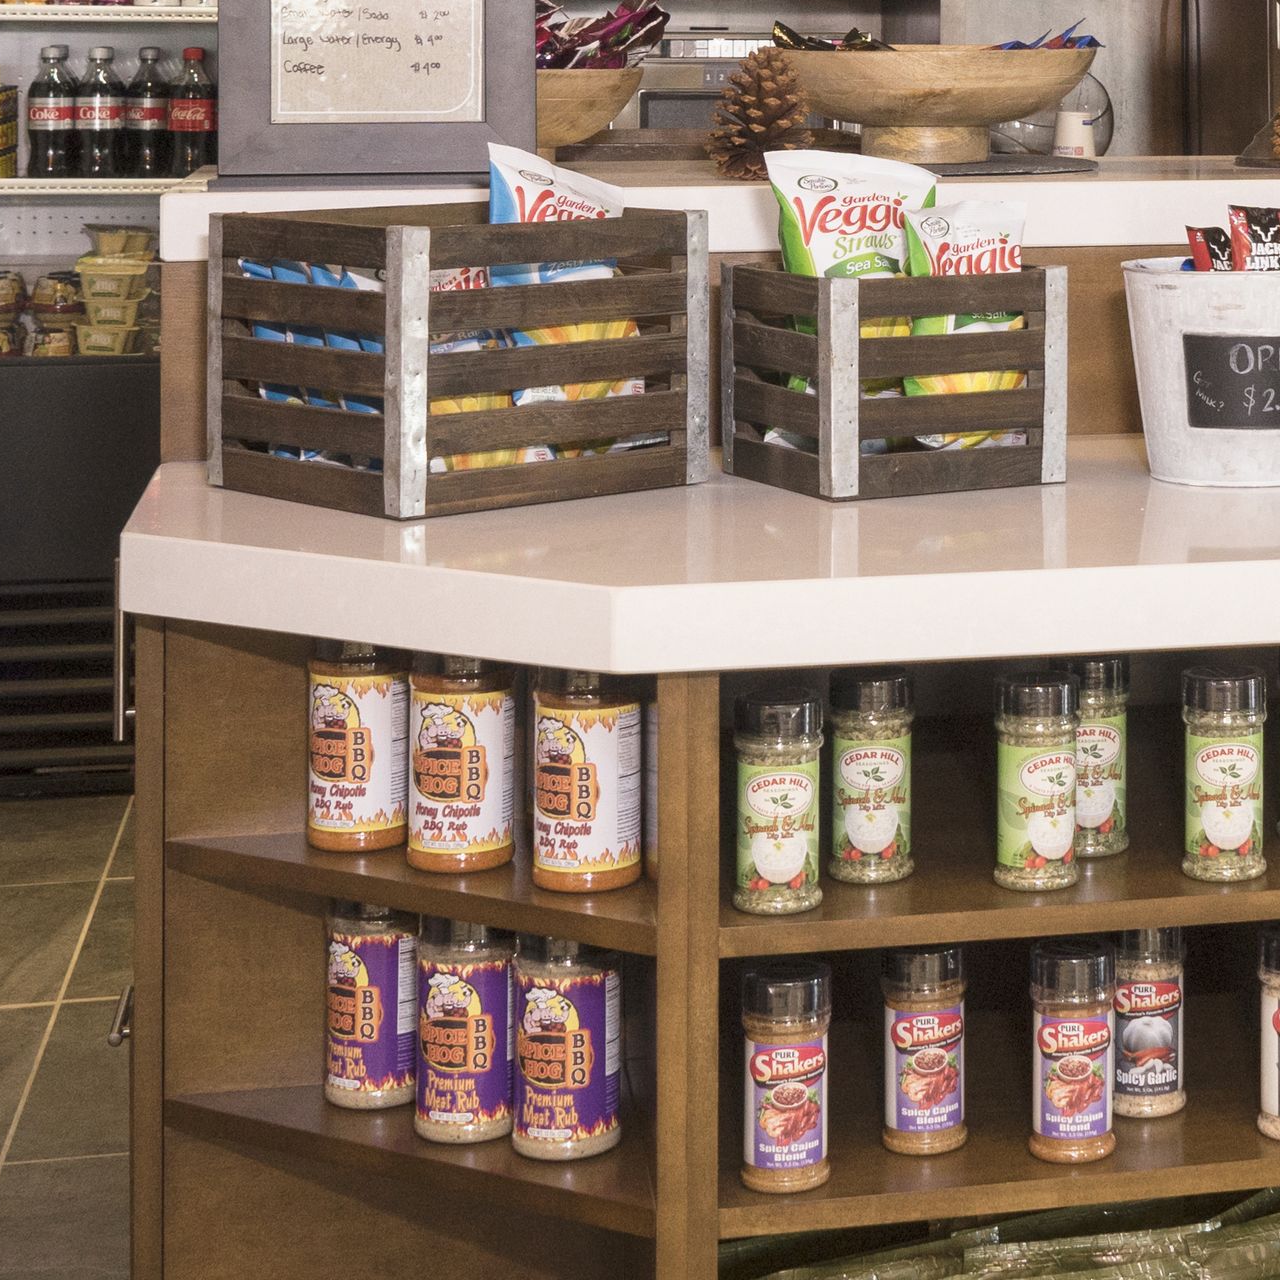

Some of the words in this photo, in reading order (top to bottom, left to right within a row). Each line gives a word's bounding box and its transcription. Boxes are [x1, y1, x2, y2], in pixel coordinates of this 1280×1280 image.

[282, 30, 315, 52] Large
[283, 59, 326, 76] Coffee
[30, 107, 60, 120] Coke
[79, 107, 110, 120] Coke
[556, 195, 596, 214] garden
[841, 192, 891, 207] garden
[832, 233, 897, 260] Straws
[951, 238, 996, 256] garden
[847, 261, 871, 274] Sea
[329, 782, 367, 800] Chipotle
[422, 775, 458, 794] HOG
[315, 798, 331, 811] BBQ
[335, 799, 354, 810] Rub
[441, 801, 481, 820] Chipotle
[422, 819, 444, 832] BBQ
[448, 820, 468, 832] Rub
[554, 821, 592, 838] Chipotle
[559, 839, 579, 850] Rub
[1134, 985, 1154, 994] PURE
[1116, 988, 1180, 1014] Shakers
[916, 1017, 936, 1026] PURE
[1060, 1024, 1082, 1033] PURE
[896, 1018, 962, 1048] Shakers
[1042, 1027, 1109, 1053] Shakers
[427, 1044, 465, 1063] HOG
[524, 1060, 562, 1079] HOG
[754, 1052, 824, 1082] Shakers
[428, 1069, 476, 1093] Premium
[1116, 1069, 1145, 1086] Spicy
[1148, 1069, 1178, 1086] Garlic
[425, 1087, 452, 1108] Meat
[456, 1091, 480, 1112] Rub
[525, 1085, 574, 1106] Premium
[523, 1103, 550, 1126] Meat
[553, 1106, 579, 1128] Rub
[901, 1107, 931, 1117] Spicy
[932, 1102, 959, 1115] Cajun
[1045, 1112, 1075, 1123] Spicy
[1075, 1111, 1104, 1123] Cajun
[917, 1114, 948, 1125] Blend
[1059, 1121, 1091, 1132] Blend
[790, 1139, 820, 1152] Cajun
[774, 1151, 807, 1162] Blend
